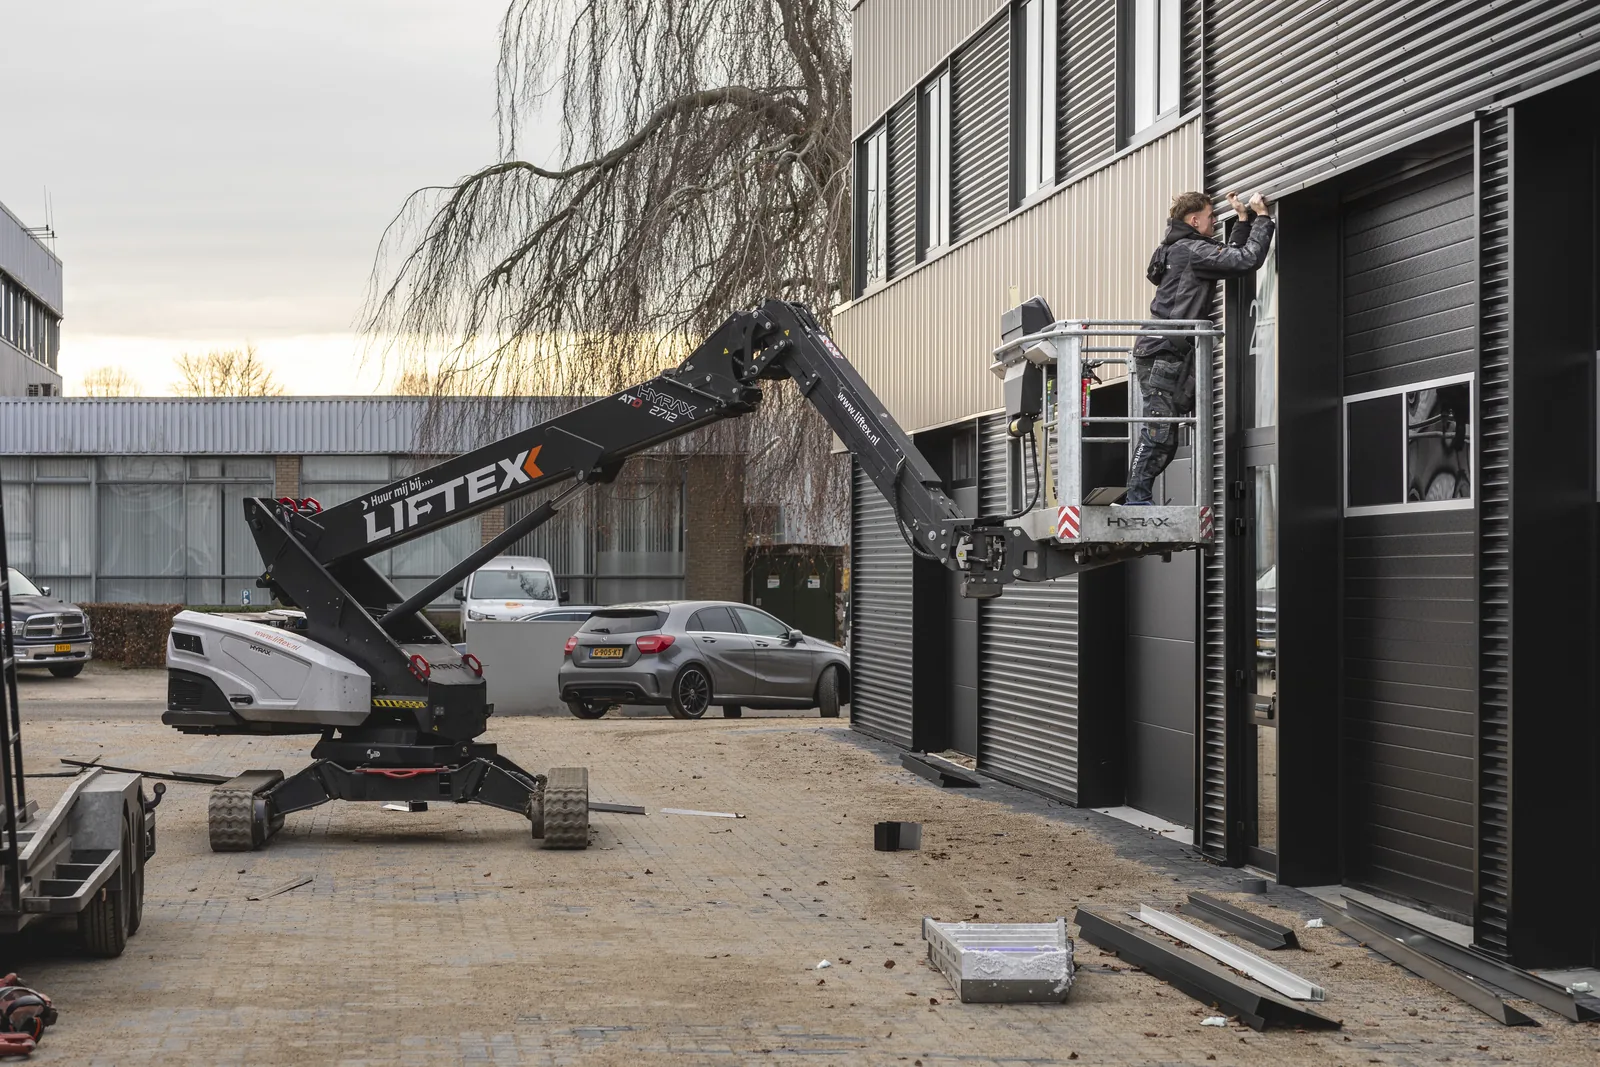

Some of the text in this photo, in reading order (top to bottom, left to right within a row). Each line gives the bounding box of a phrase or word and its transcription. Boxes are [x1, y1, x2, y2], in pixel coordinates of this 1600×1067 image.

[637, 384, 697, 420] HYRAX
[649, 405, 678, 423] 27.12
[837, 392, 880, 446] www.liftex.nl
[364, 450, 531, 543] LIFTEX
[370, 490, 393, 507] Huur
[394, 482, 409, 496] mij
[250, 645, 271, 656] HYRAX
[255, 631, 301, 650] www.liftex.nl
